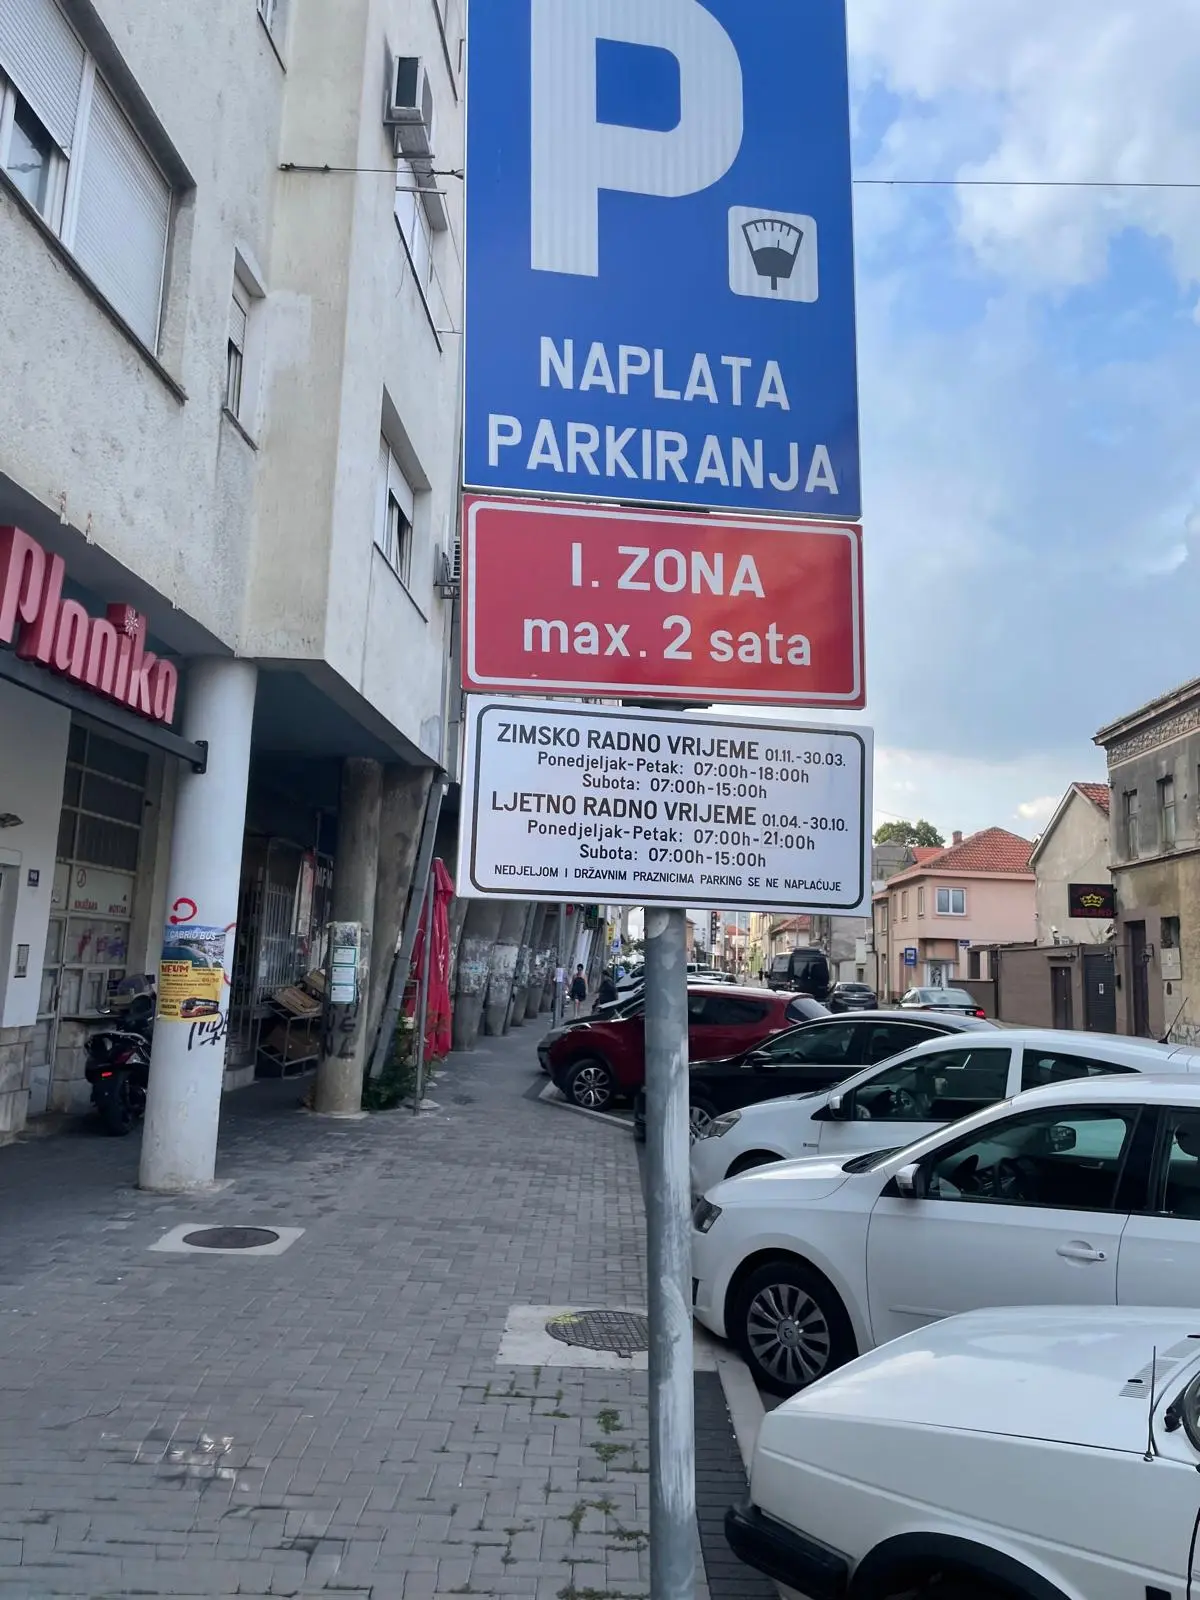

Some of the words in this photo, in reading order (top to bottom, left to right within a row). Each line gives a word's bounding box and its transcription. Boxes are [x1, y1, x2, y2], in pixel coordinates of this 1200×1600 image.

[531, 0, 743, 277] P
[539, 336, 790, 411] NAPLATA
[488, 413, 839, 495] PARKIRANJA
[571, 542, 599, 588] I.
[617, 545, 765, 598] ZONA
[0, 526, 178, 724] Planika
[523, 617, 646, 658] max.
[662, 615, 692, 661] 2
[709, 622, 811, 666] sata
[497, 722, 580, 748] ZIMSKO
[587, 729, 661, 753] RADNO
[667, 735, 760, 760] VRIJEME
[538, 751, 683, 774] Ponedjeljak-Petak:
[694, 762, 809, 783] 07:00h-18:00h
[582, 773, 640, 791] Subota:
[650, 778, 767, 798] 07:00h-15:00h
[492, 790, 576, 815] LJETNO
[583, 796, 657, 820] RADNO
[664, 801, 757, 826] VRIJEME
[527, 819, 683, 843] Ponedjeljak-Petak:
[580, 843, 638, 861] Subota:
[649, 848, 766, 868] 07:00h-15:00h
[494, 864, 559, 877] NEDJELJOM
[564, 868, 568, 878] I
[574, 866, 627, 881] DRŽAVNIM
[633, 871, 694, 884] PRAZNICIMA
[700, 874, 742, 887] PARKING
[748, 876, 760, 887] SE
[765, 877, 779, 888] NE
[784, 877, 841, 892] NAPLAĆUJE
[169, 930, 198, 939] CABRIO
[200, 930, 216, 940] BUS
